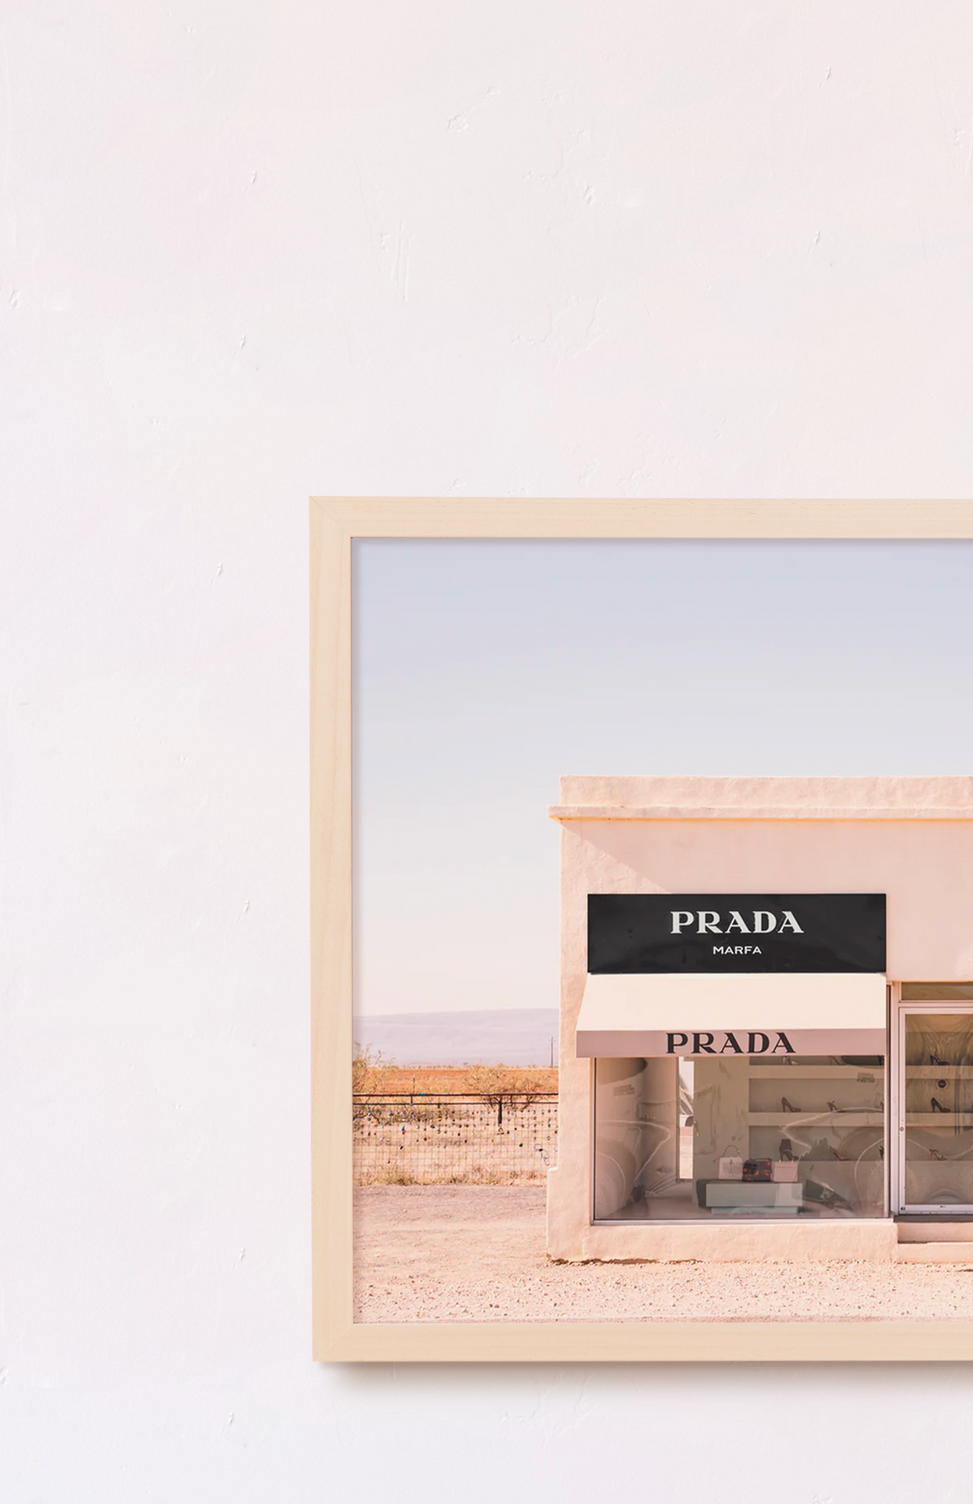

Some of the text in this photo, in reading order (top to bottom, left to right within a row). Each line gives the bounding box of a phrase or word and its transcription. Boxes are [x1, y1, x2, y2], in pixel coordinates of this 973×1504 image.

[670, 911, 804, 934] PRADA
[712, 946, 762, 955] MARFA
[666, 1032, 796, 1054] PRADA
